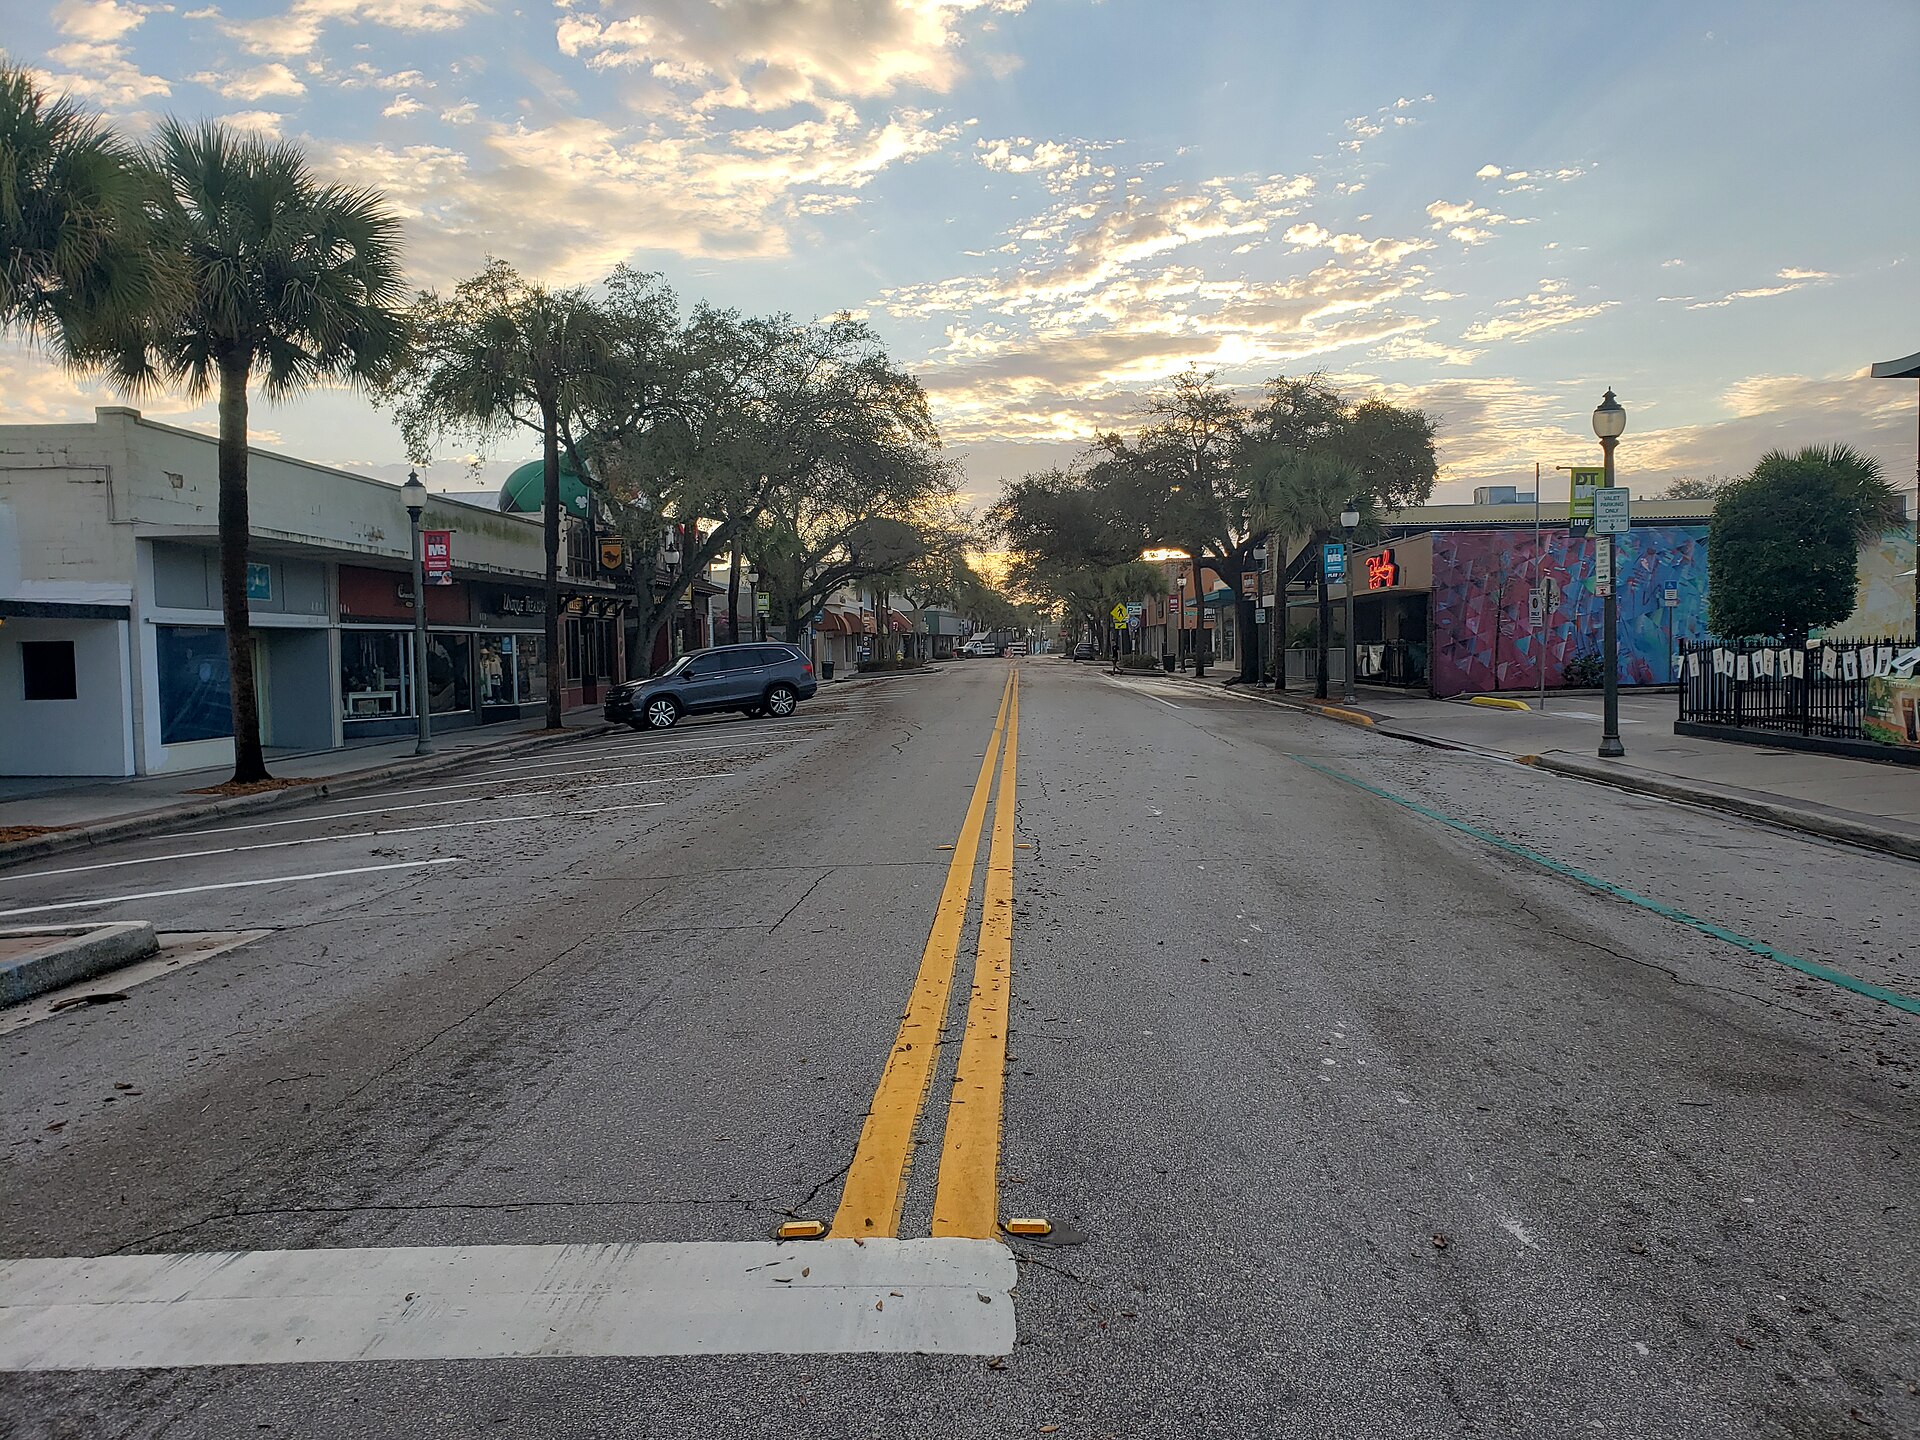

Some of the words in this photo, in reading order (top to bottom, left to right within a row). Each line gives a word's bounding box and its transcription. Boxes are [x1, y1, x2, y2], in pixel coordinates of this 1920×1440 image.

[1575, 472, 1598, 485] DT
[428, 545, 446, 556] MB
[1328, 554, 1341, 562] MB
